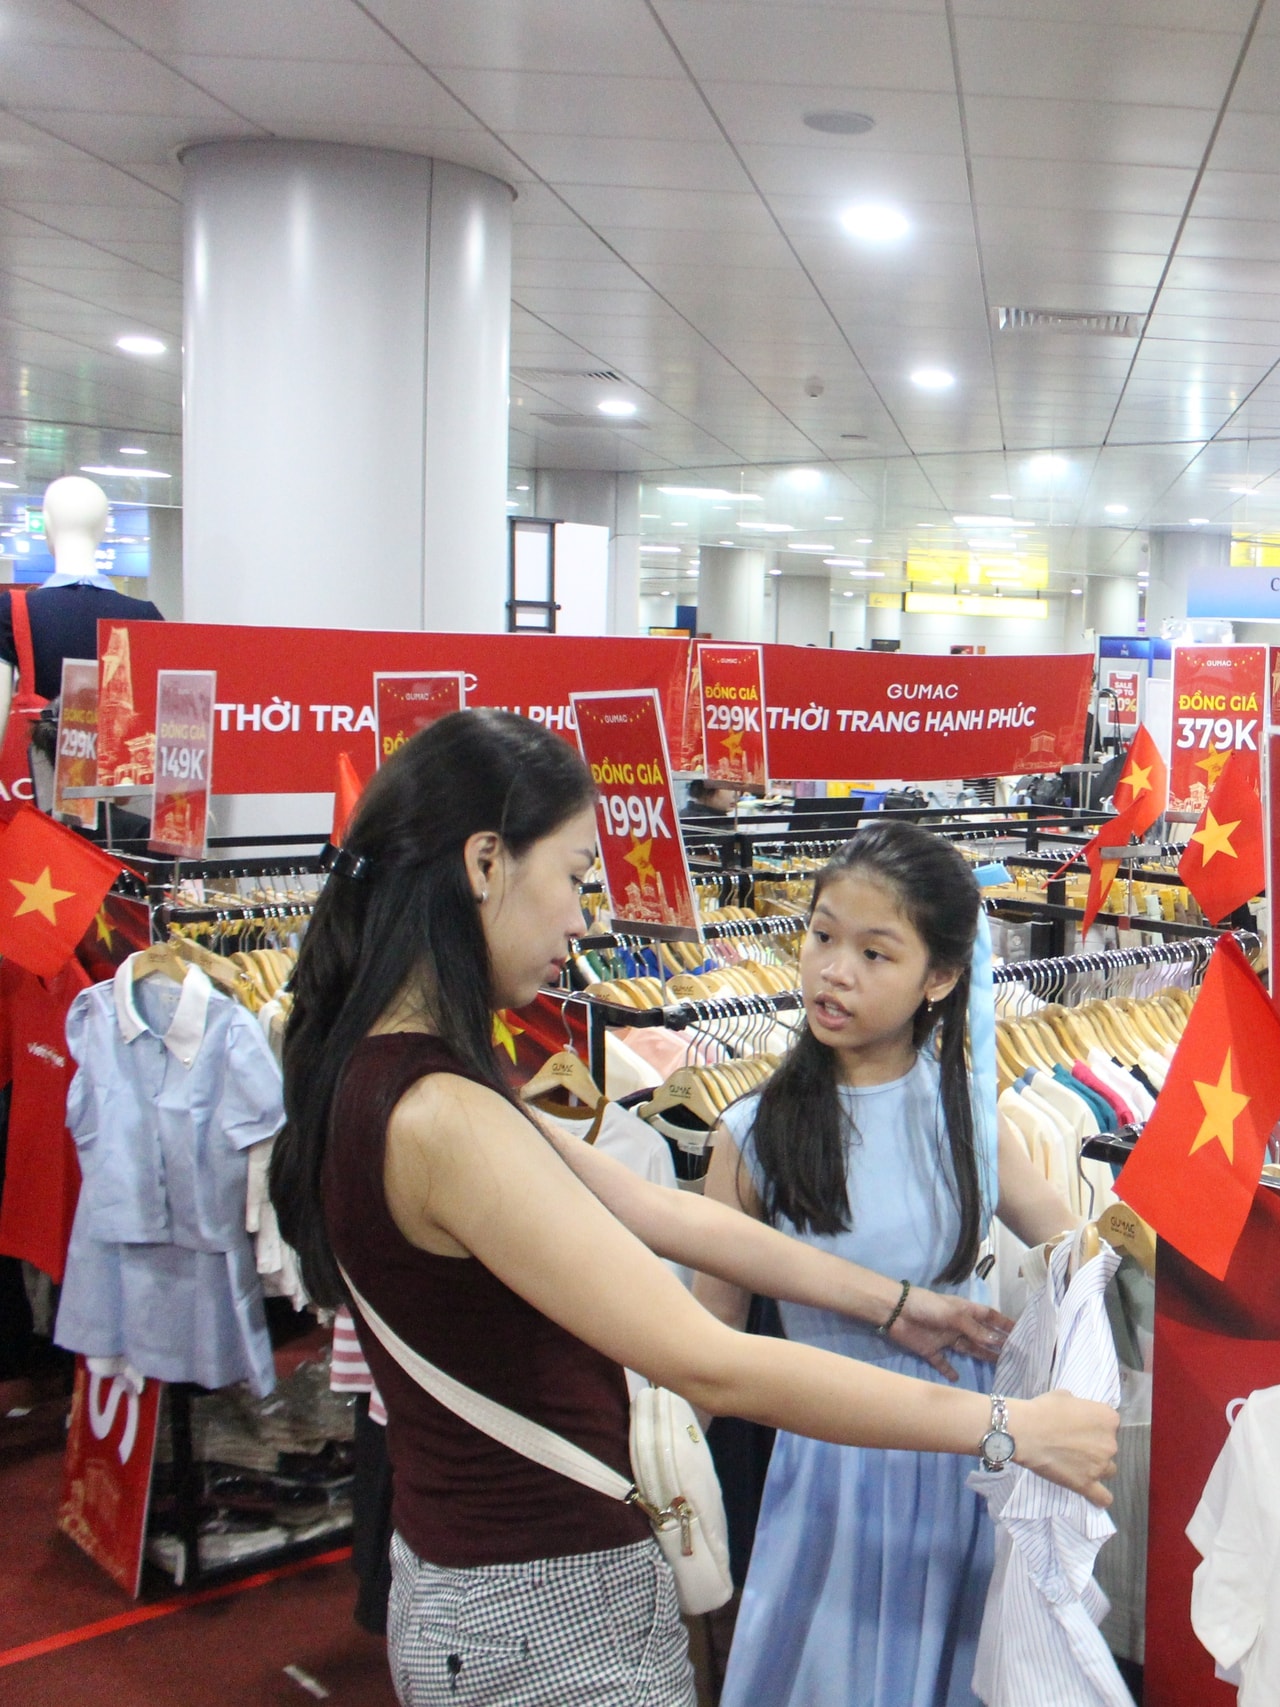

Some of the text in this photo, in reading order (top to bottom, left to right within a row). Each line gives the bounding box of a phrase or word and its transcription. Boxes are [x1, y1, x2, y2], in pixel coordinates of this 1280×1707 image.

[705, 682, 759, 701] ĐỒNG GIÁ
[887, 683, 959, 700] GUMAC
[1114, 681, 1133, 689] SALE
[214, 696, 300, 732] THỜI
[309, 705, 376, 732] TRA
[1178, 690, 1258, 712] ĐỒNG GIÁ
[706, 704, 760, 732] 299K
[766, 702, 1037, 737] THỜI TRANG HẠNH PHÚC
[1176, 717, 1258, 751] 379K
[160, 746, 206, 780] 149K
[590, 756, 664, 785] ĐỒNG GIÁ
[599, 794, 672, 839] 199K
